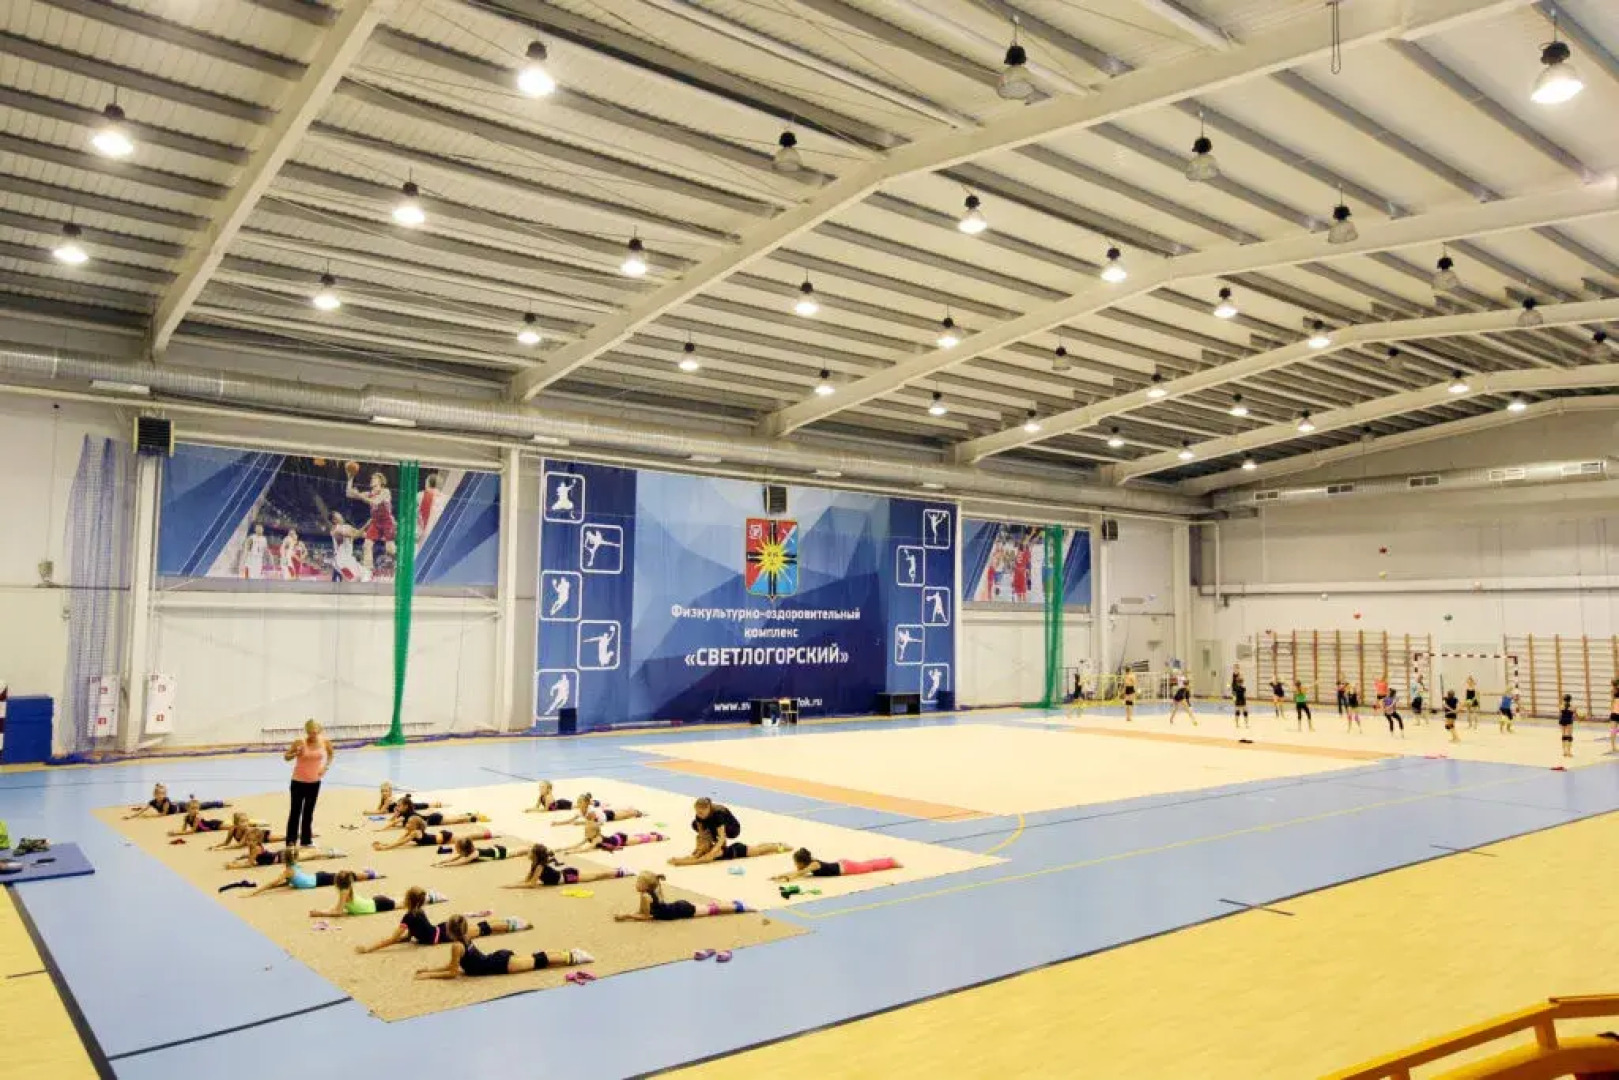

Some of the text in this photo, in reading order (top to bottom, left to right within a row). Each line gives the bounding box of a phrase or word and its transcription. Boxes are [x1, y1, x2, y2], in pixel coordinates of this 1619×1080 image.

[671, 604, 860, 621] Физкультурно-оздоровительный
[744, 627, 799, 638] комплекс
[684, 643, 849, 666] «СВЕТЛОГОРСКИЙ»
